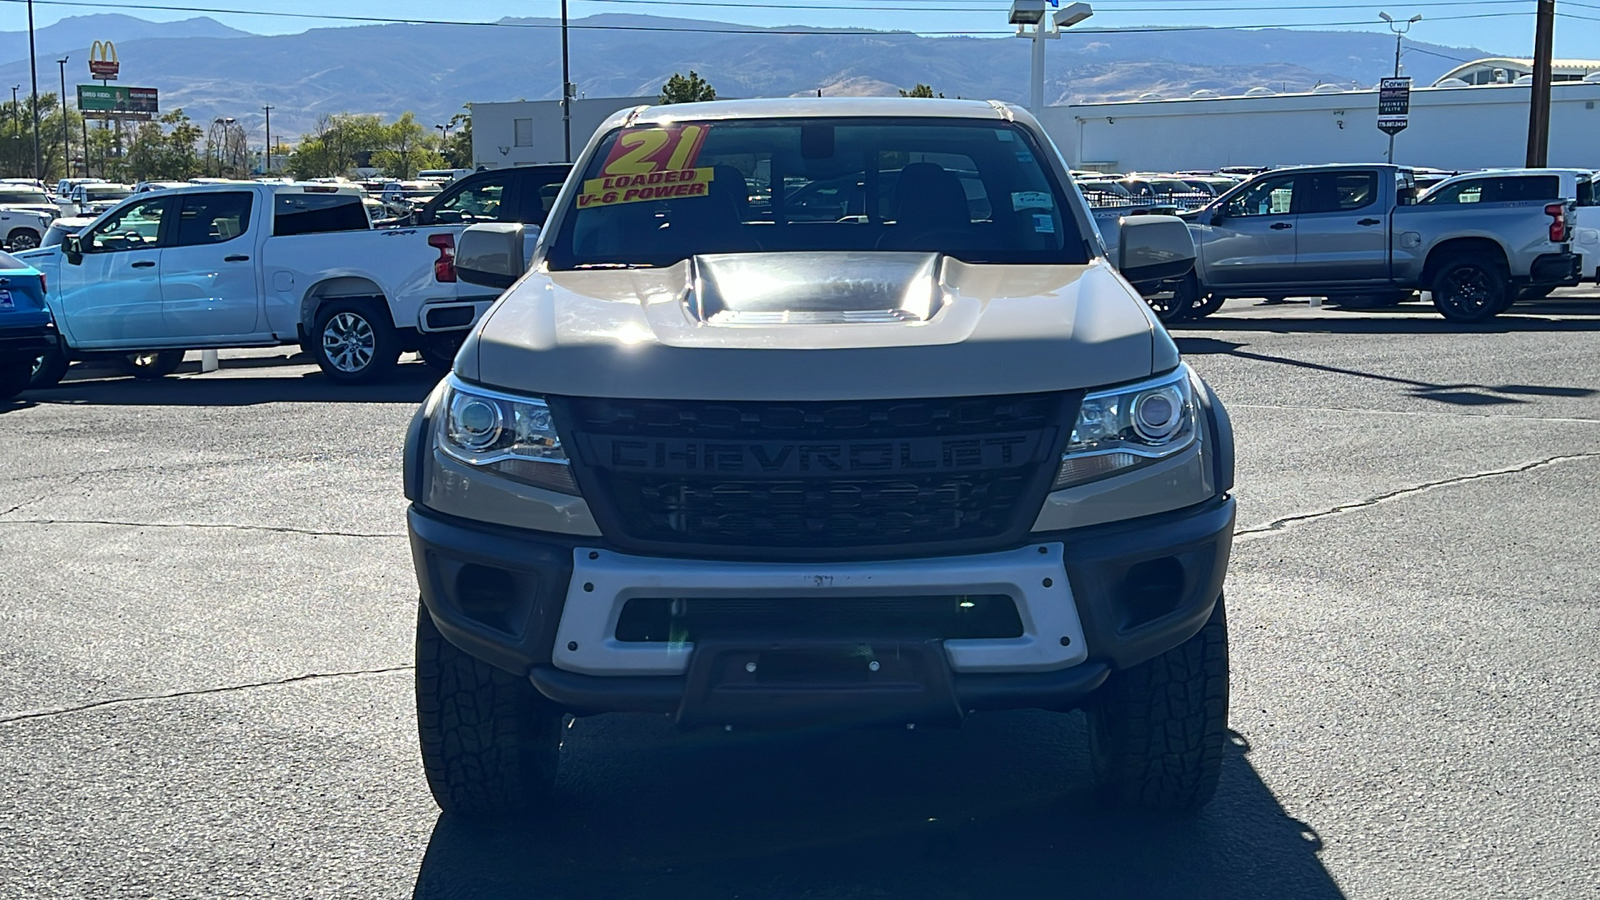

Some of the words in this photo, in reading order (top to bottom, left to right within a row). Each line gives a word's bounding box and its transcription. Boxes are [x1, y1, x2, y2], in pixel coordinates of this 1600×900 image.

[605, 125, 702, 174] 21
[579, 192, 619, 206] V-6
[622, 183, 706, 202] POWER
[602, 170, 697, 190] LOADED
[611, 435, 1027, 471] CHEVROLET
